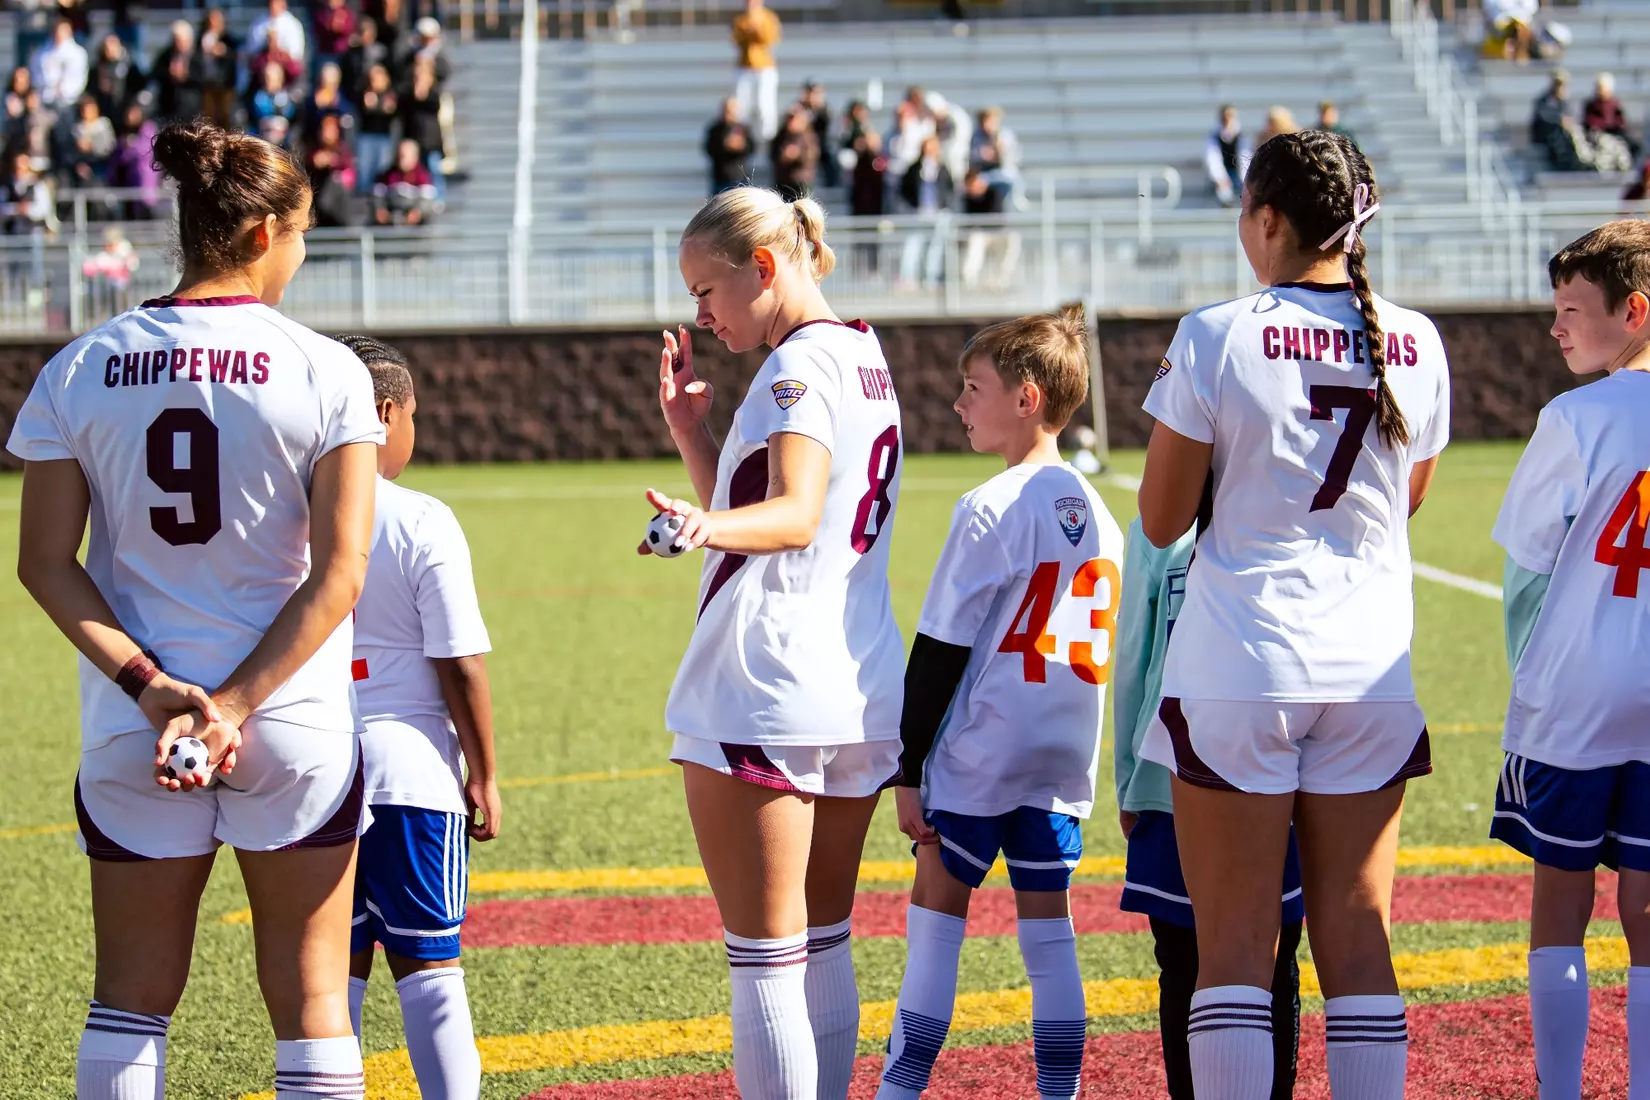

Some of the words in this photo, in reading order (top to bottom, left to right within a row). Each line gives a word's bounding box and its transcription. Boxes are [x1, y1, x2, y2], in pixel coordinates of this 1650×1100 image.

[104, 348, 271, 388] CHIPPEWAS
[775, 388, 805, 399] MAC
[1263, 326, 1418, 366] CHIPPEAS
[146, 408, 222, 546] 9
[851, 425, 898, 555] 8
[1309, 385, 1376, 512] 7
[998, 558, 1121, 684] 43
